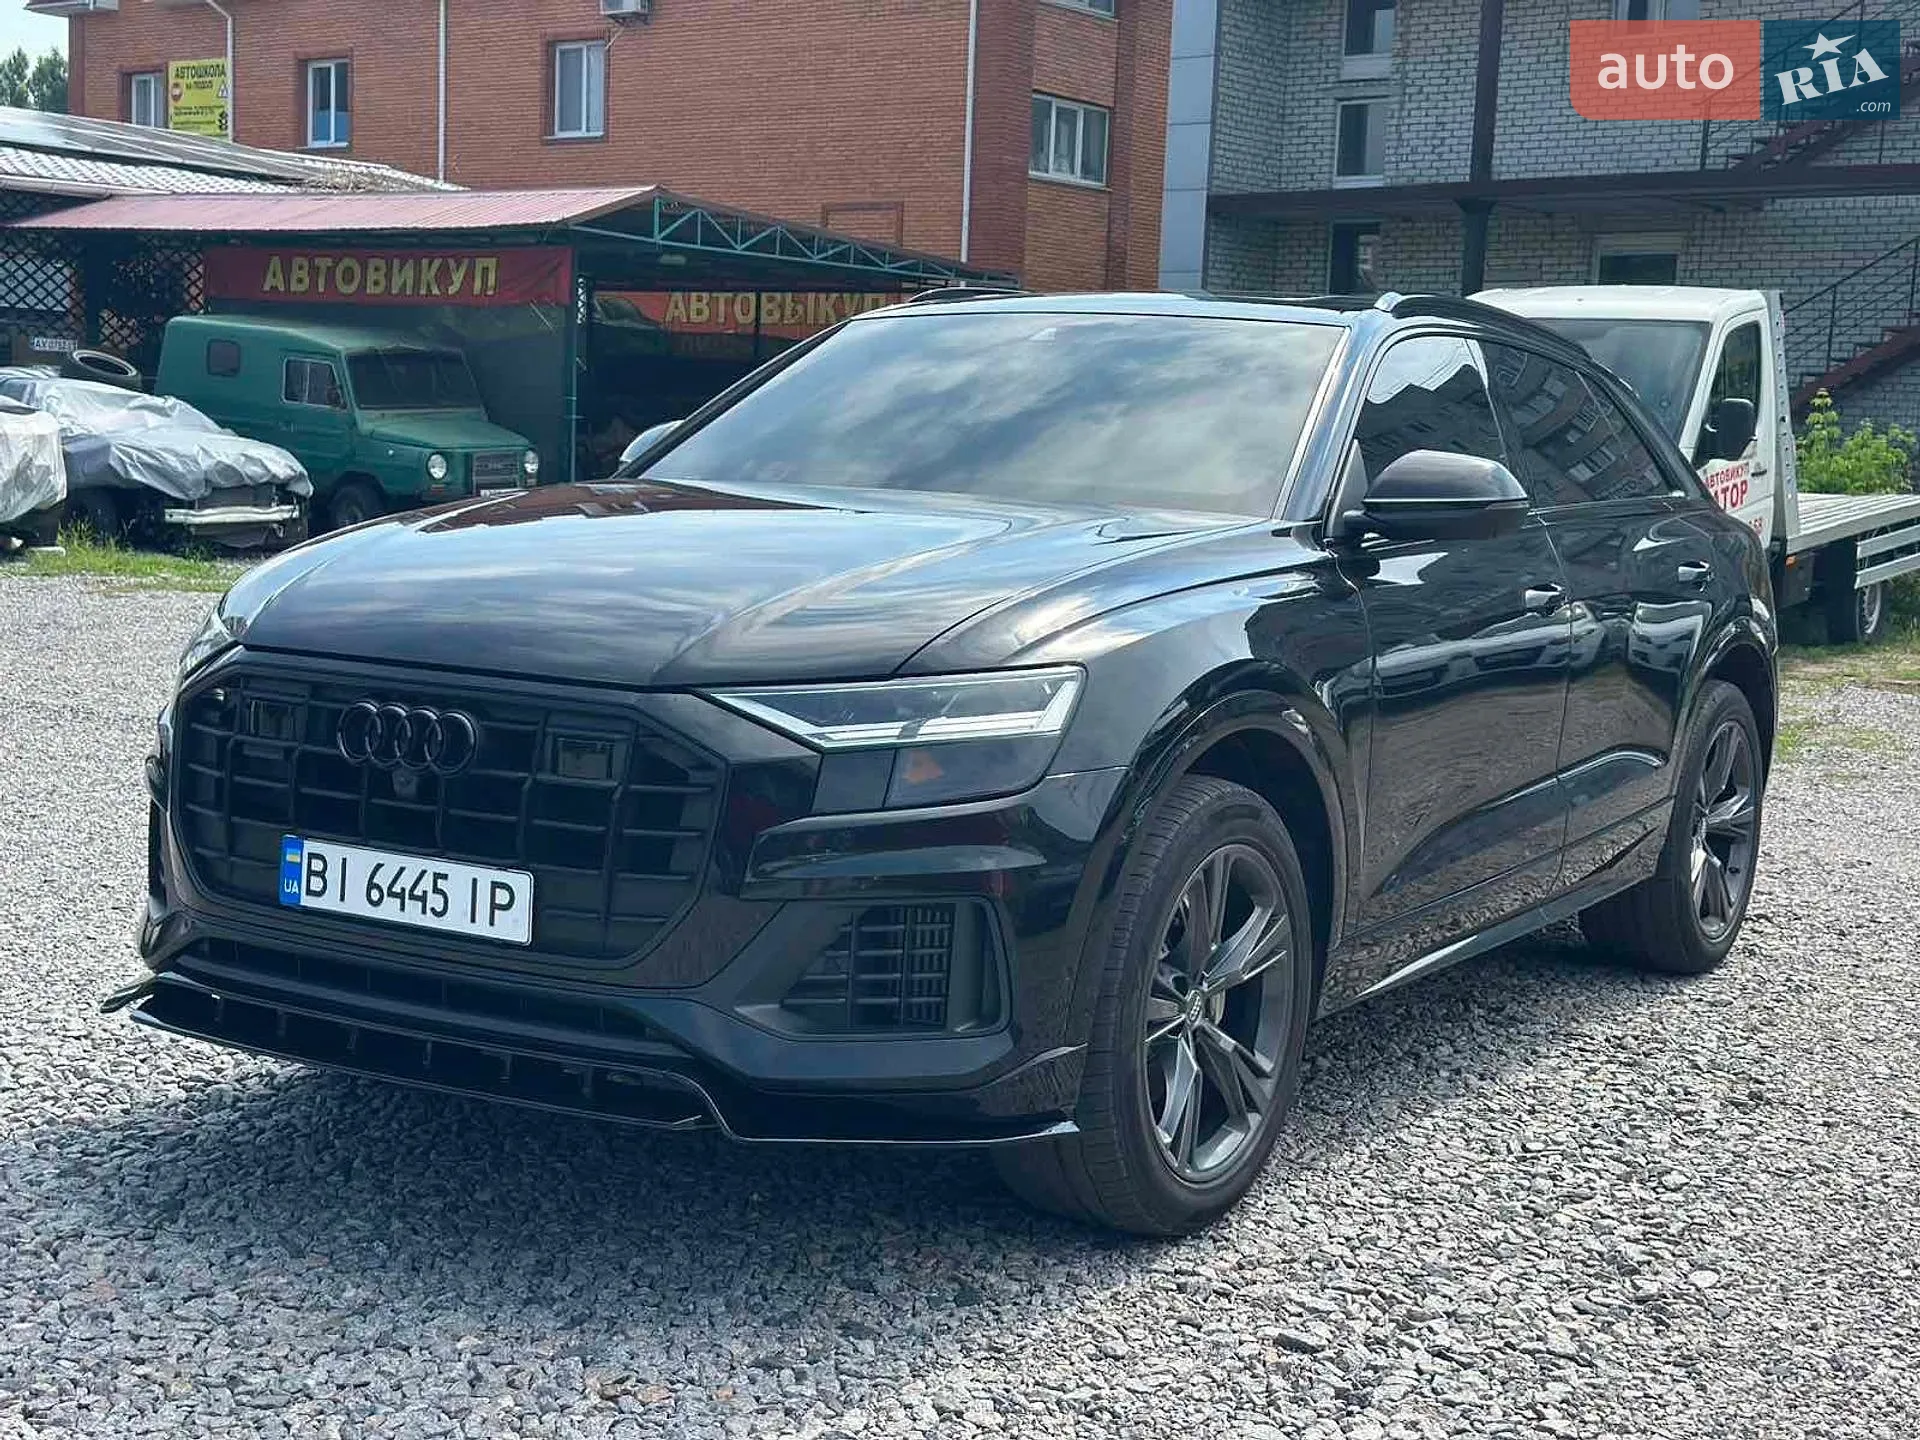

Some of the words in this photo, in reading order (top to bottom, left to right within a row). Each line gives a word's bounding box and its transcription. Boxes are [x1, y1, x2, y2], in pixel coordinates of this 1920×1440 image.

[174, 63, 227, 80] АВТОШКОЛА
[263, 256, 499, 296] АВТОВИКУП
[284, 879, 299, 895] UA
[304, 852, 348, 902] BI
[365, 862, 450, 918] 6445
[469, 876, 517, 928] IP
